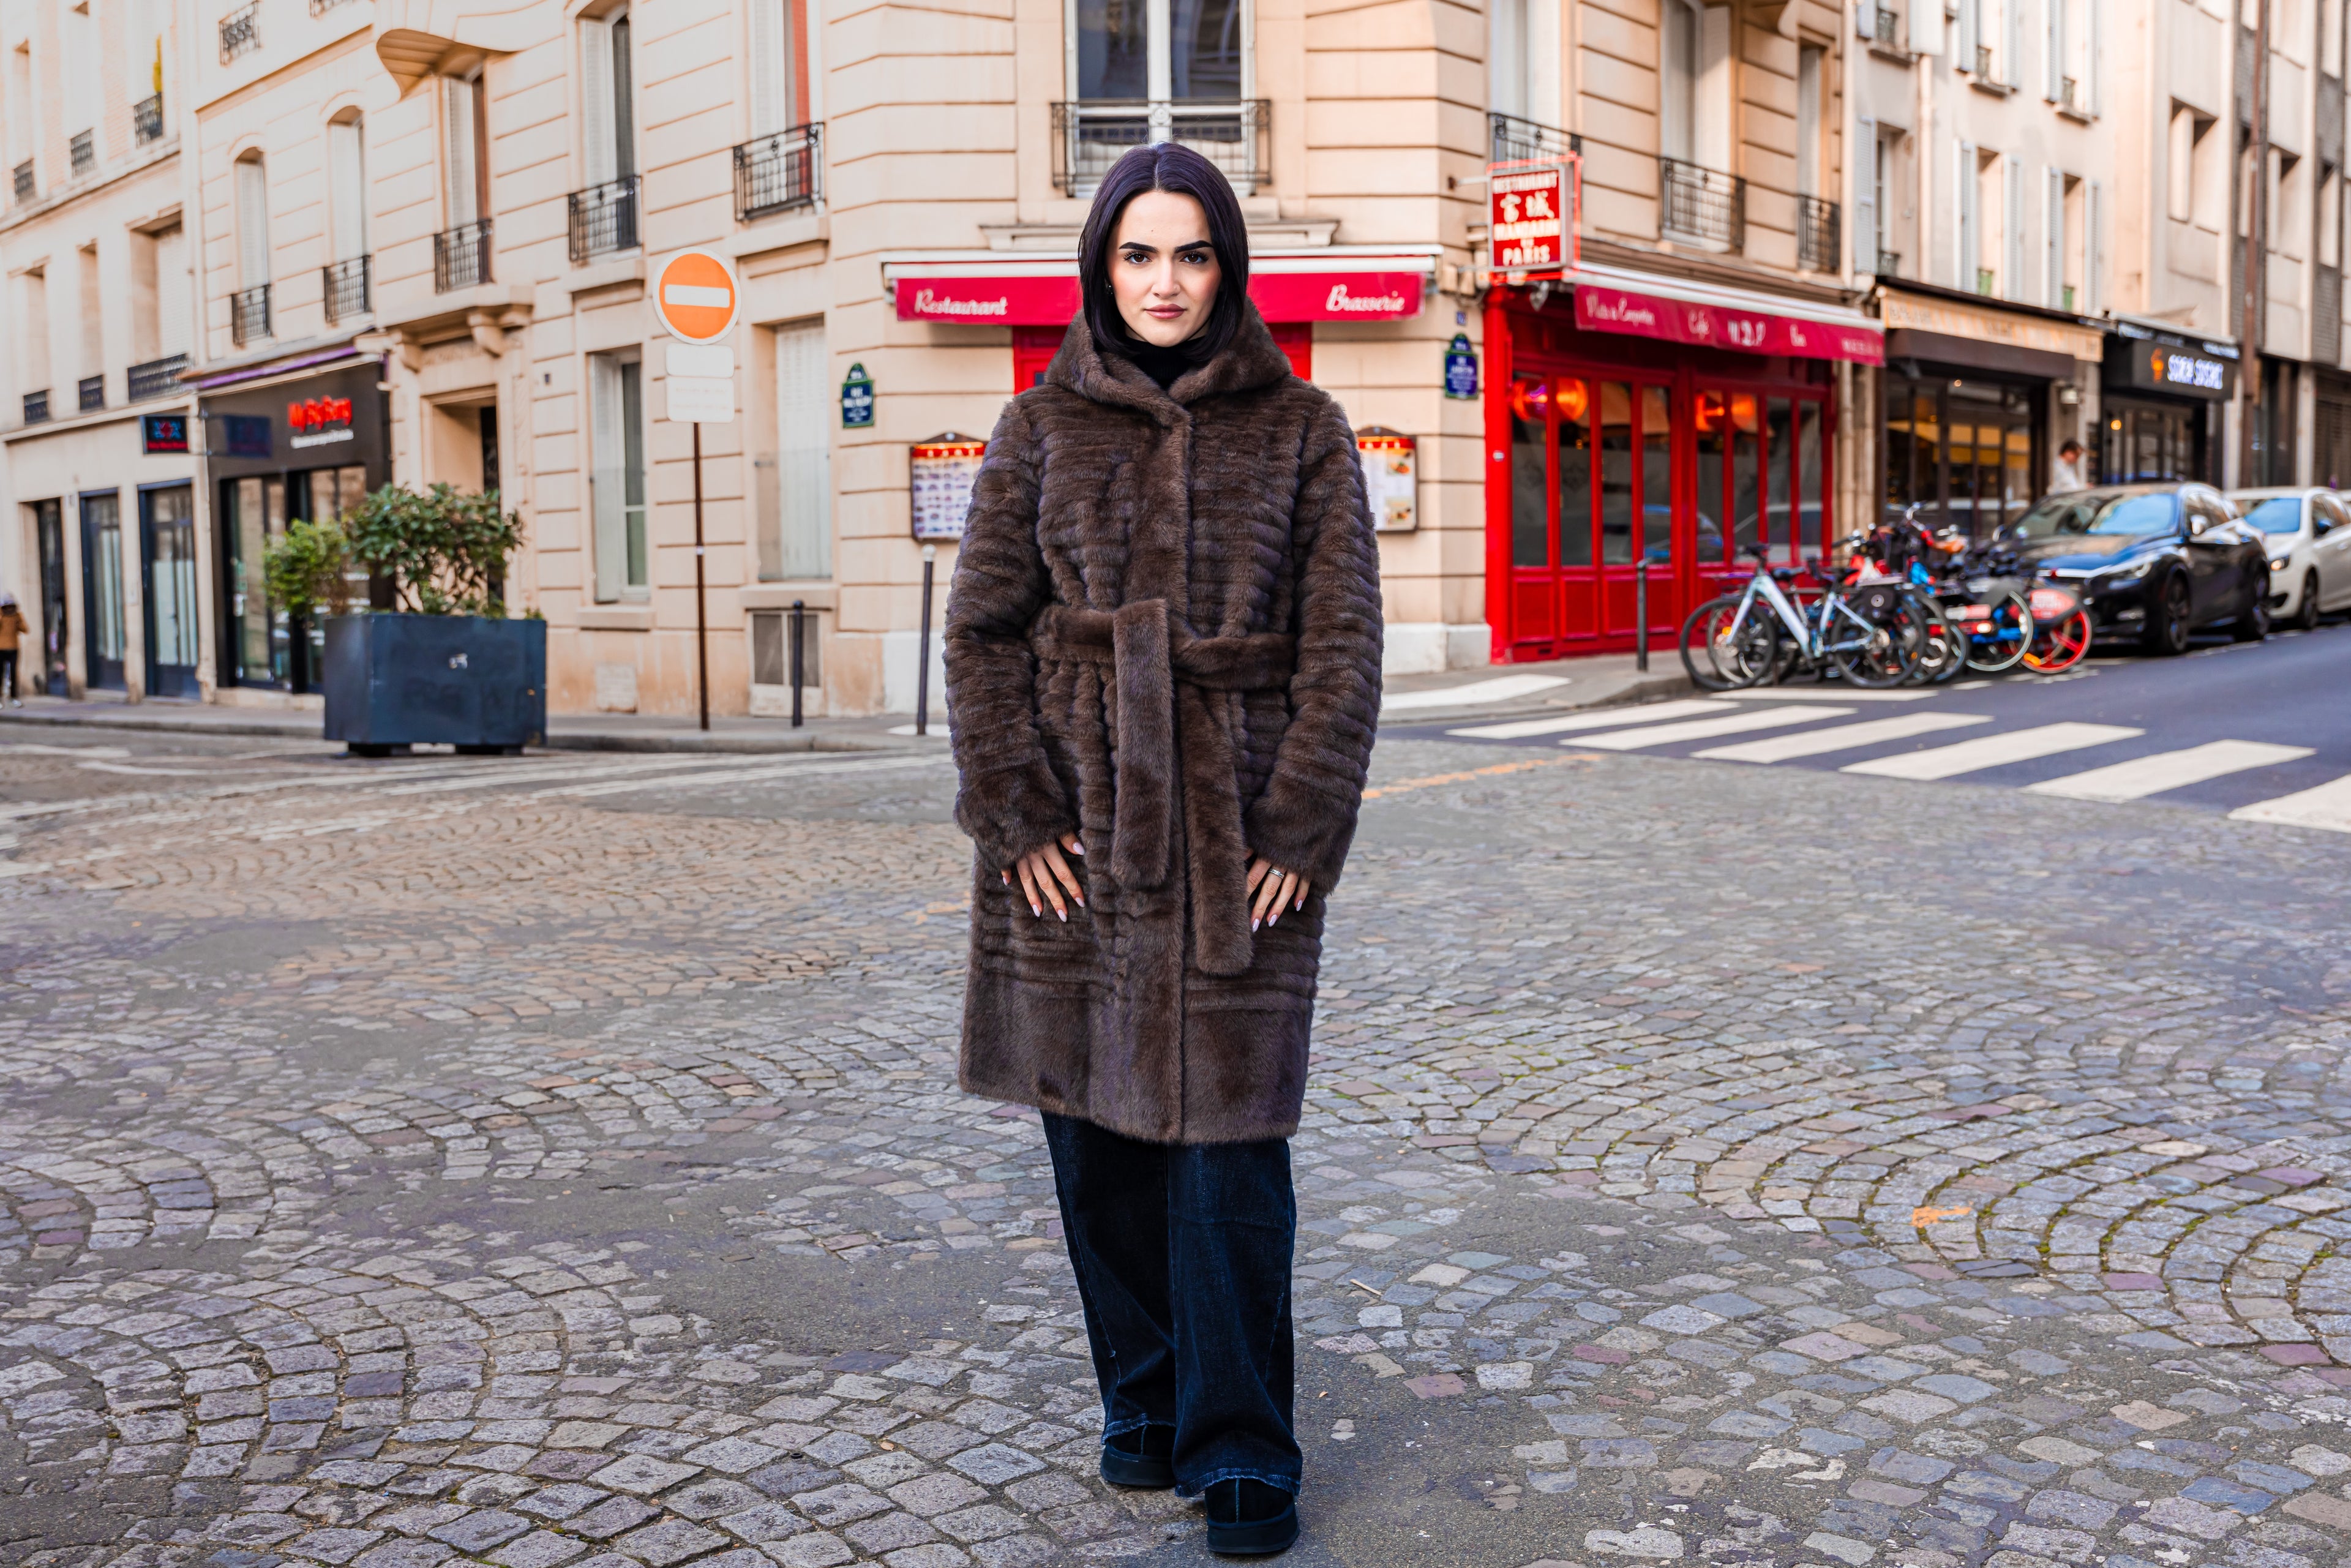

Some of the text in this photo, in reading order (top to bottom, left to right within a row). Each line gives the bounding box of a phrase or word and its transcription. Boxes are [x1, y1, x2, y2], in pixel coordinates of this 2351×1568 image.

[1494, 219, 1561, 241] MANDARIN
[1502, 245, 1551, 266] PARIS
[914, 288, 1008, 315] Restaurant
[1325, 284, 1406, 312] Brasserie
